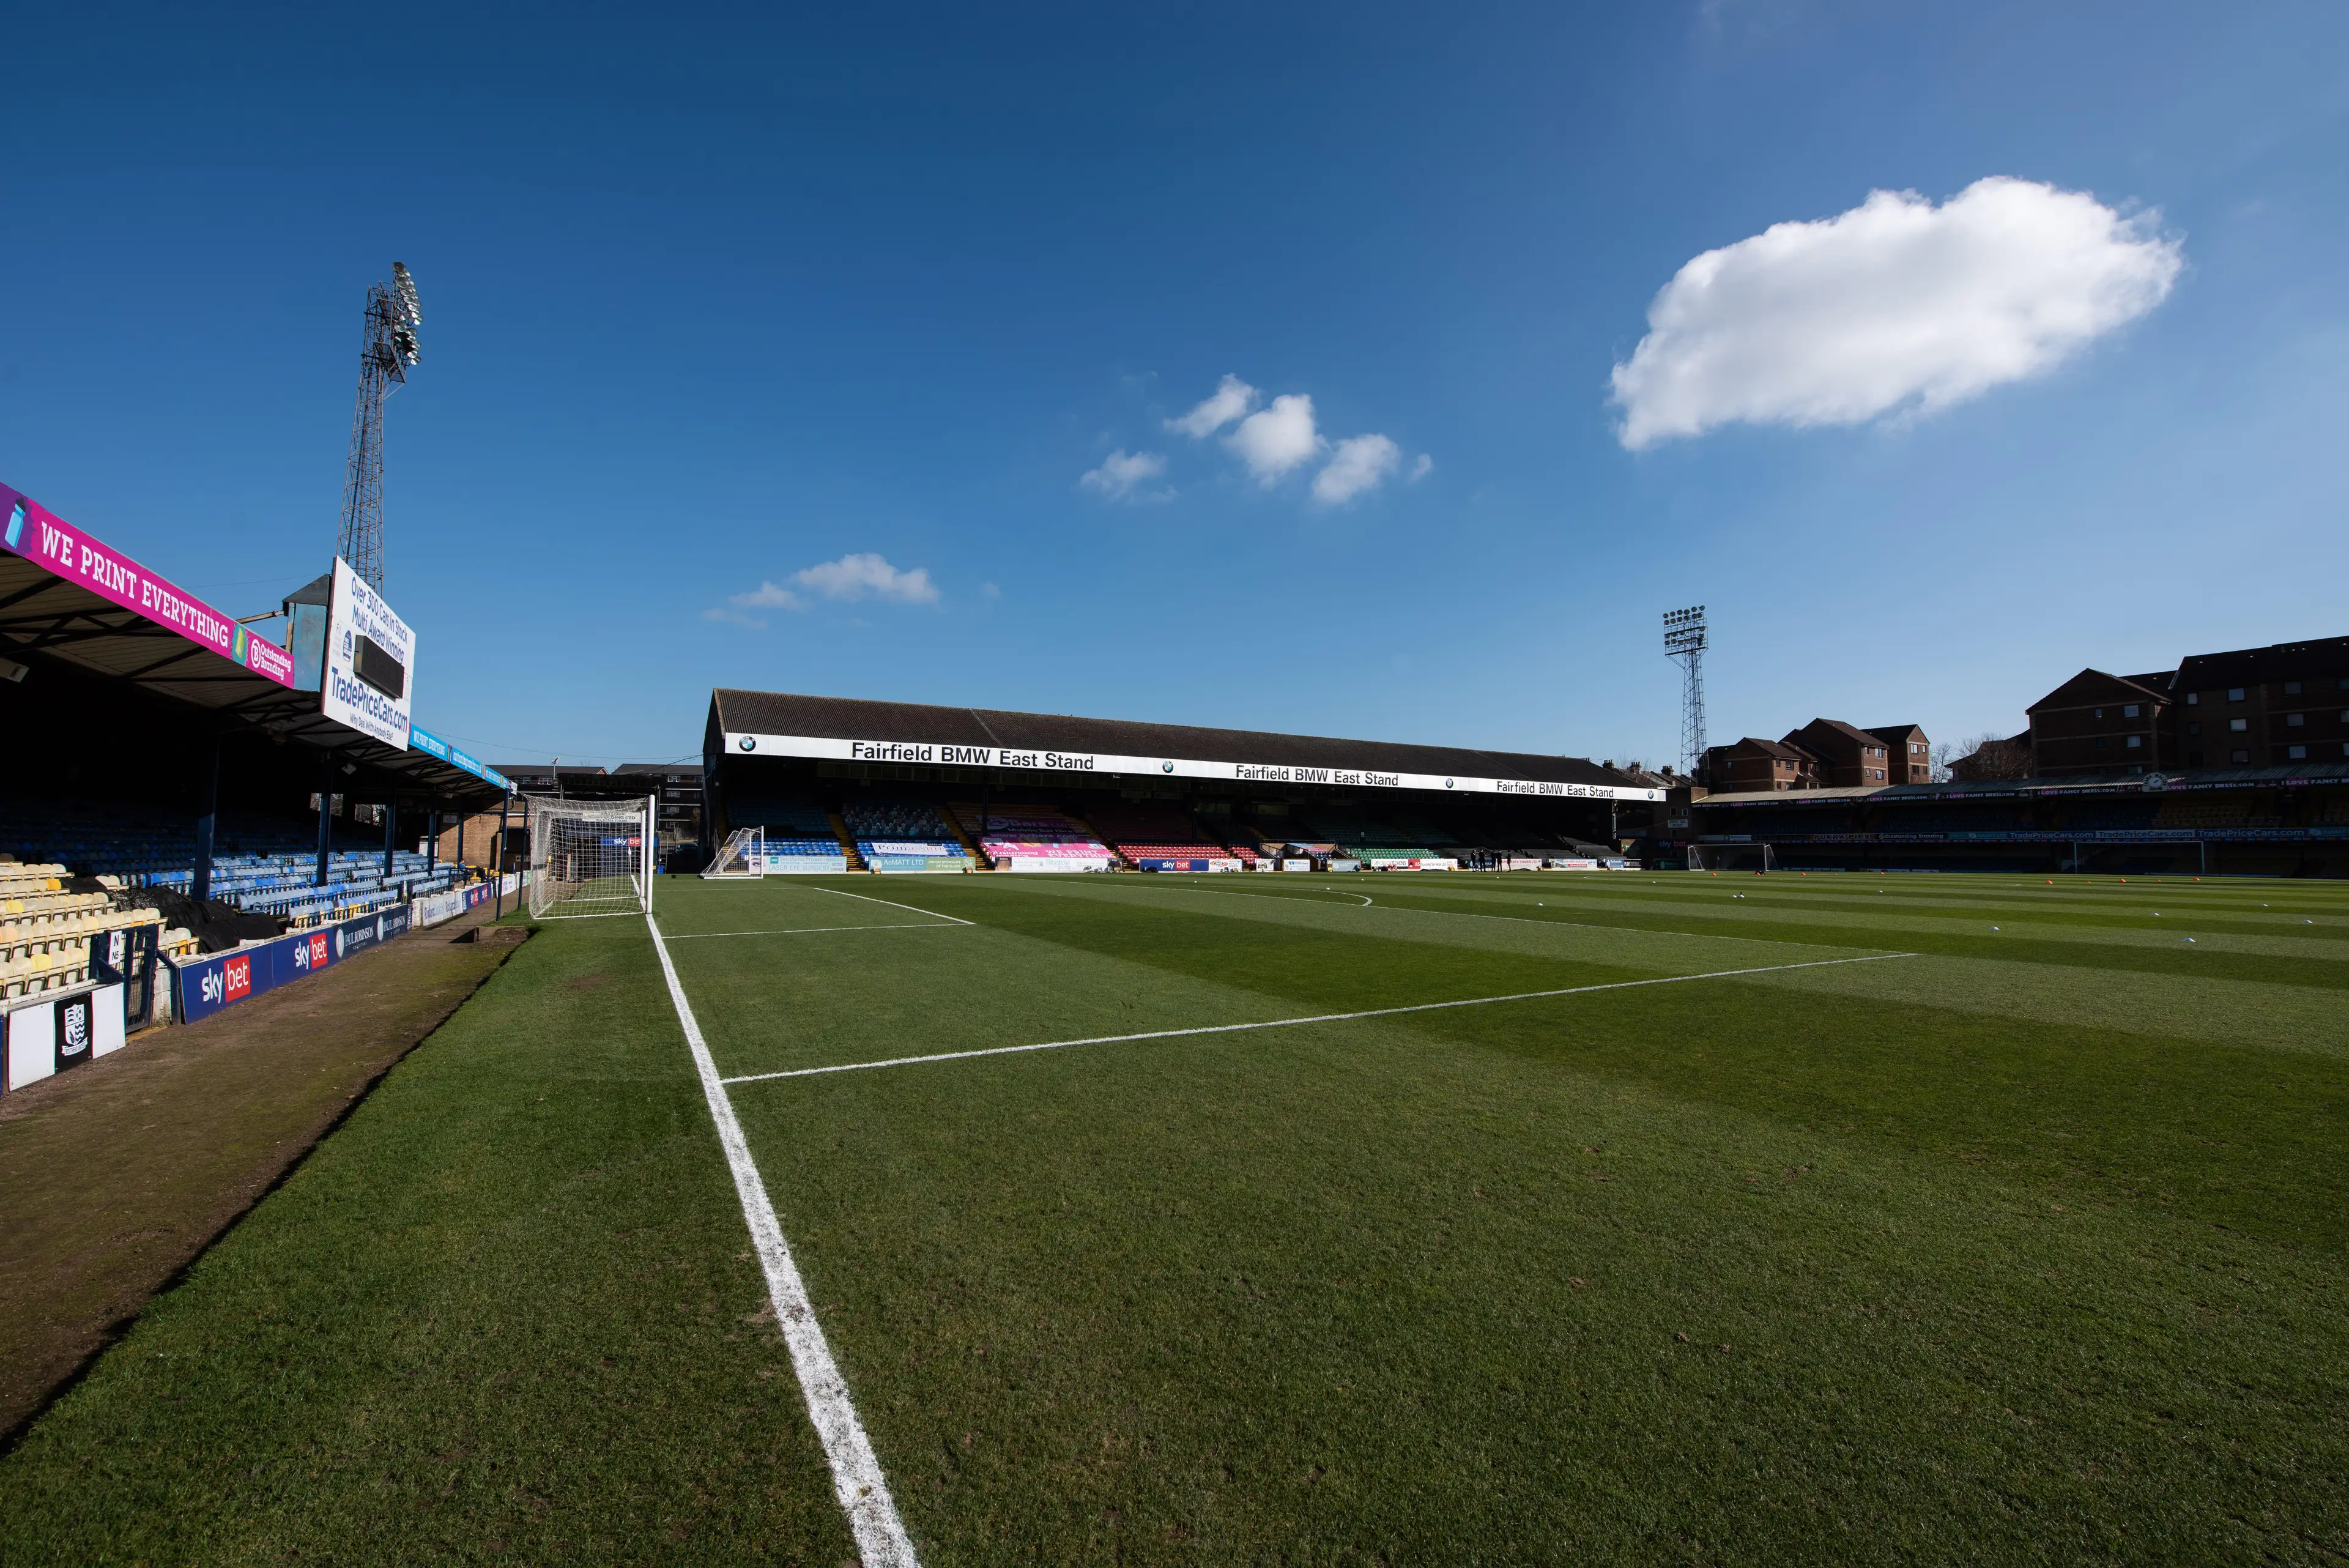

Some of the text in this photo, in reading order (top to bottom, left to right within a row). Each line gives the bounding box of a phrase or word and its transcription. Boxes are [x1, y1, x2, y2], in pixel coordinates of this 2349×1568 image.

[42, 521, 228, 648] WE PRINT EVERYTHING
[351, 577, 408, 644] Over 300 Cars In Stock
[352, 604, 368, 633] Multi
[368, 619, 386, 647] Award
[386, 633, 404, 664] Winning
[261, 644, 291, 671] Outstanding
[261, 656, 284, 681] Branding
[332, 666, 407, 734] TradePriceCars.com
[366, 719, 374, 734] With
[374, 723, 387, 740] Anybody
[852, 741, 1094, 770] Fairfield BMW East Stand
[1236, 765, 1398, 786] Fairfield BMW East Stand
[1497, 781, 1614, 798] Fairfield BMW East Stand
[1658, 840, 1672, 849] sky
[1162, 860, 1174, 869] sky
[113, 935, 119, 947] N
[345, 934, 355, 947] PAUL
[355, 926, 374, 943] ROBINSON
[112, 951, 119, 960] N5
[295, 941, 310, 970] sky
[311, 938, 327, 962] bet
[201, 962, 248, 1003] sky bet
